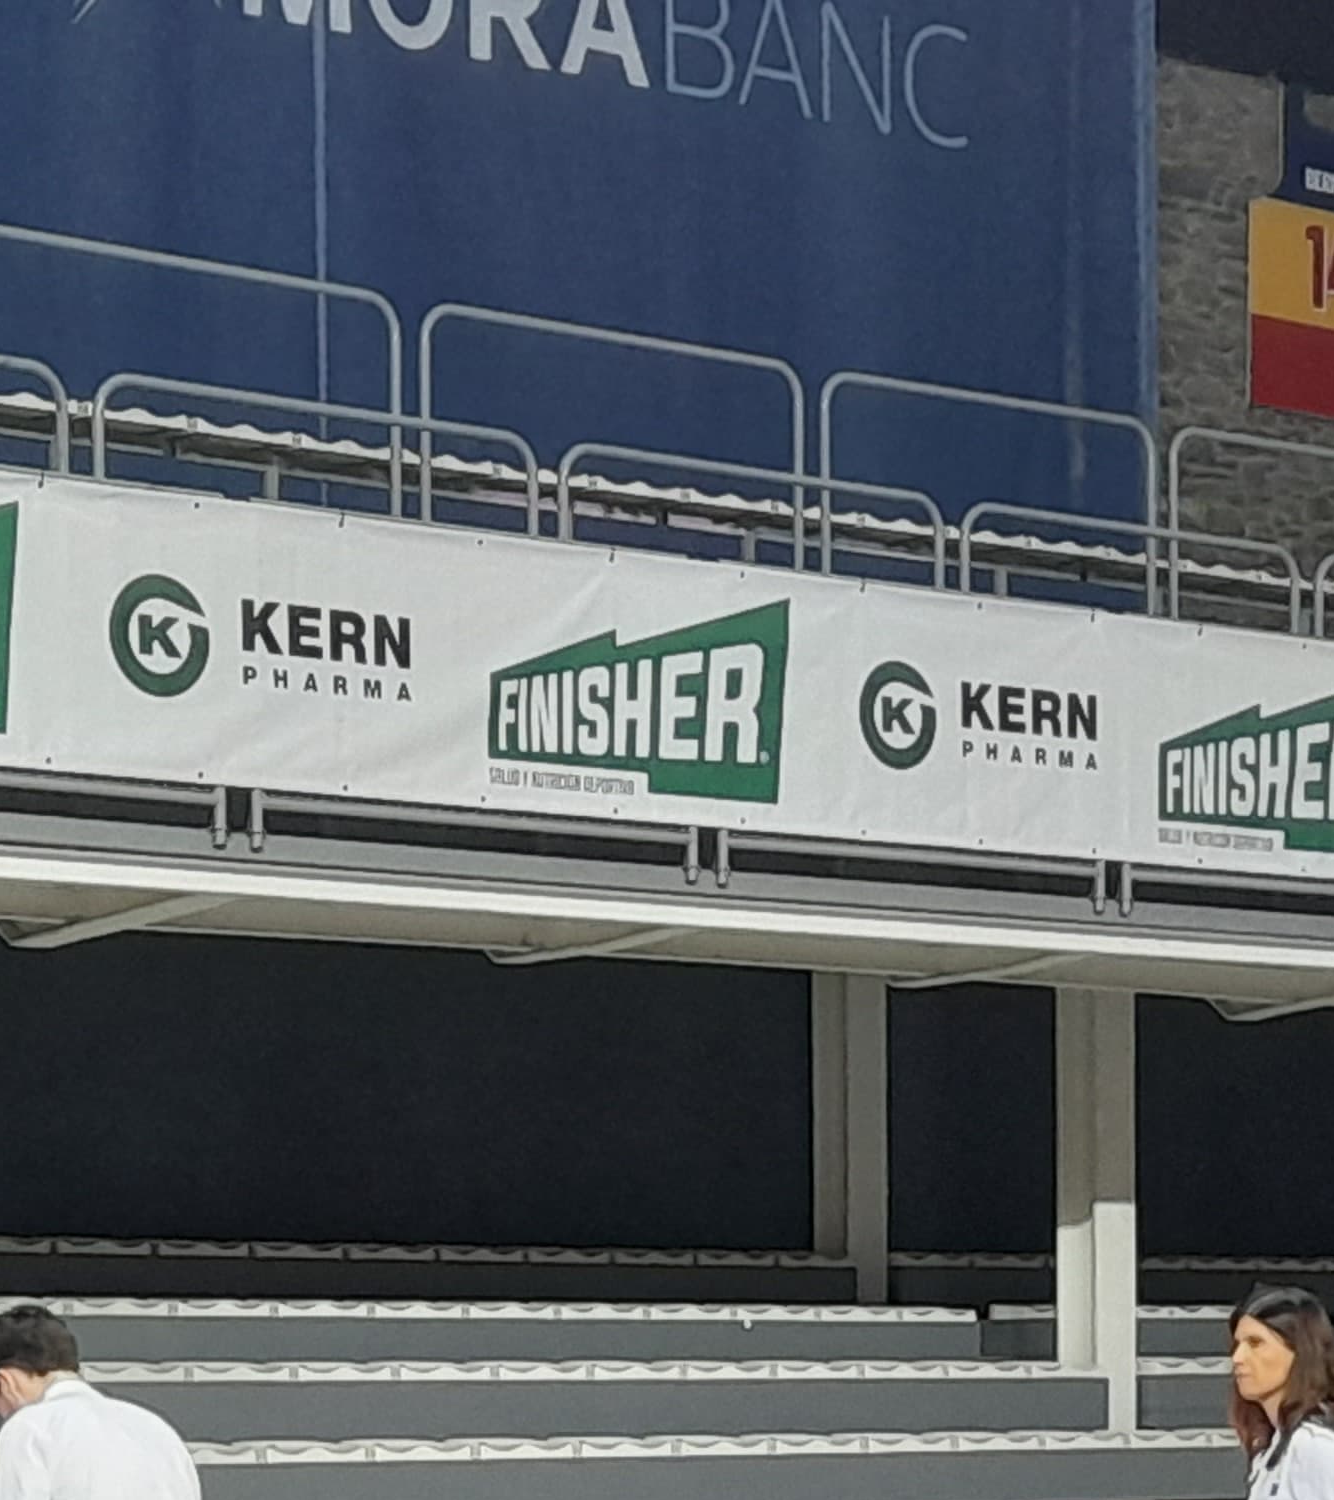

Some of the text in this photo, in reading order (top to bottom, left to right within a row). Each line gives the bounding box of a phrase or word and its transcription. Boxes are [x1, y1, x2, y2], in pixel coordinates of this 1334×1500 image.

[244, 0, 968, 149] RABANC
[240, 598, 412, 670] KERN
[242, 667, 413, 702] PHARMA
[497, 642, 760, 764] FINISHER
[959, 681, 1098, 743] KERN
[961, 740, 1098, 772] PHARMA
